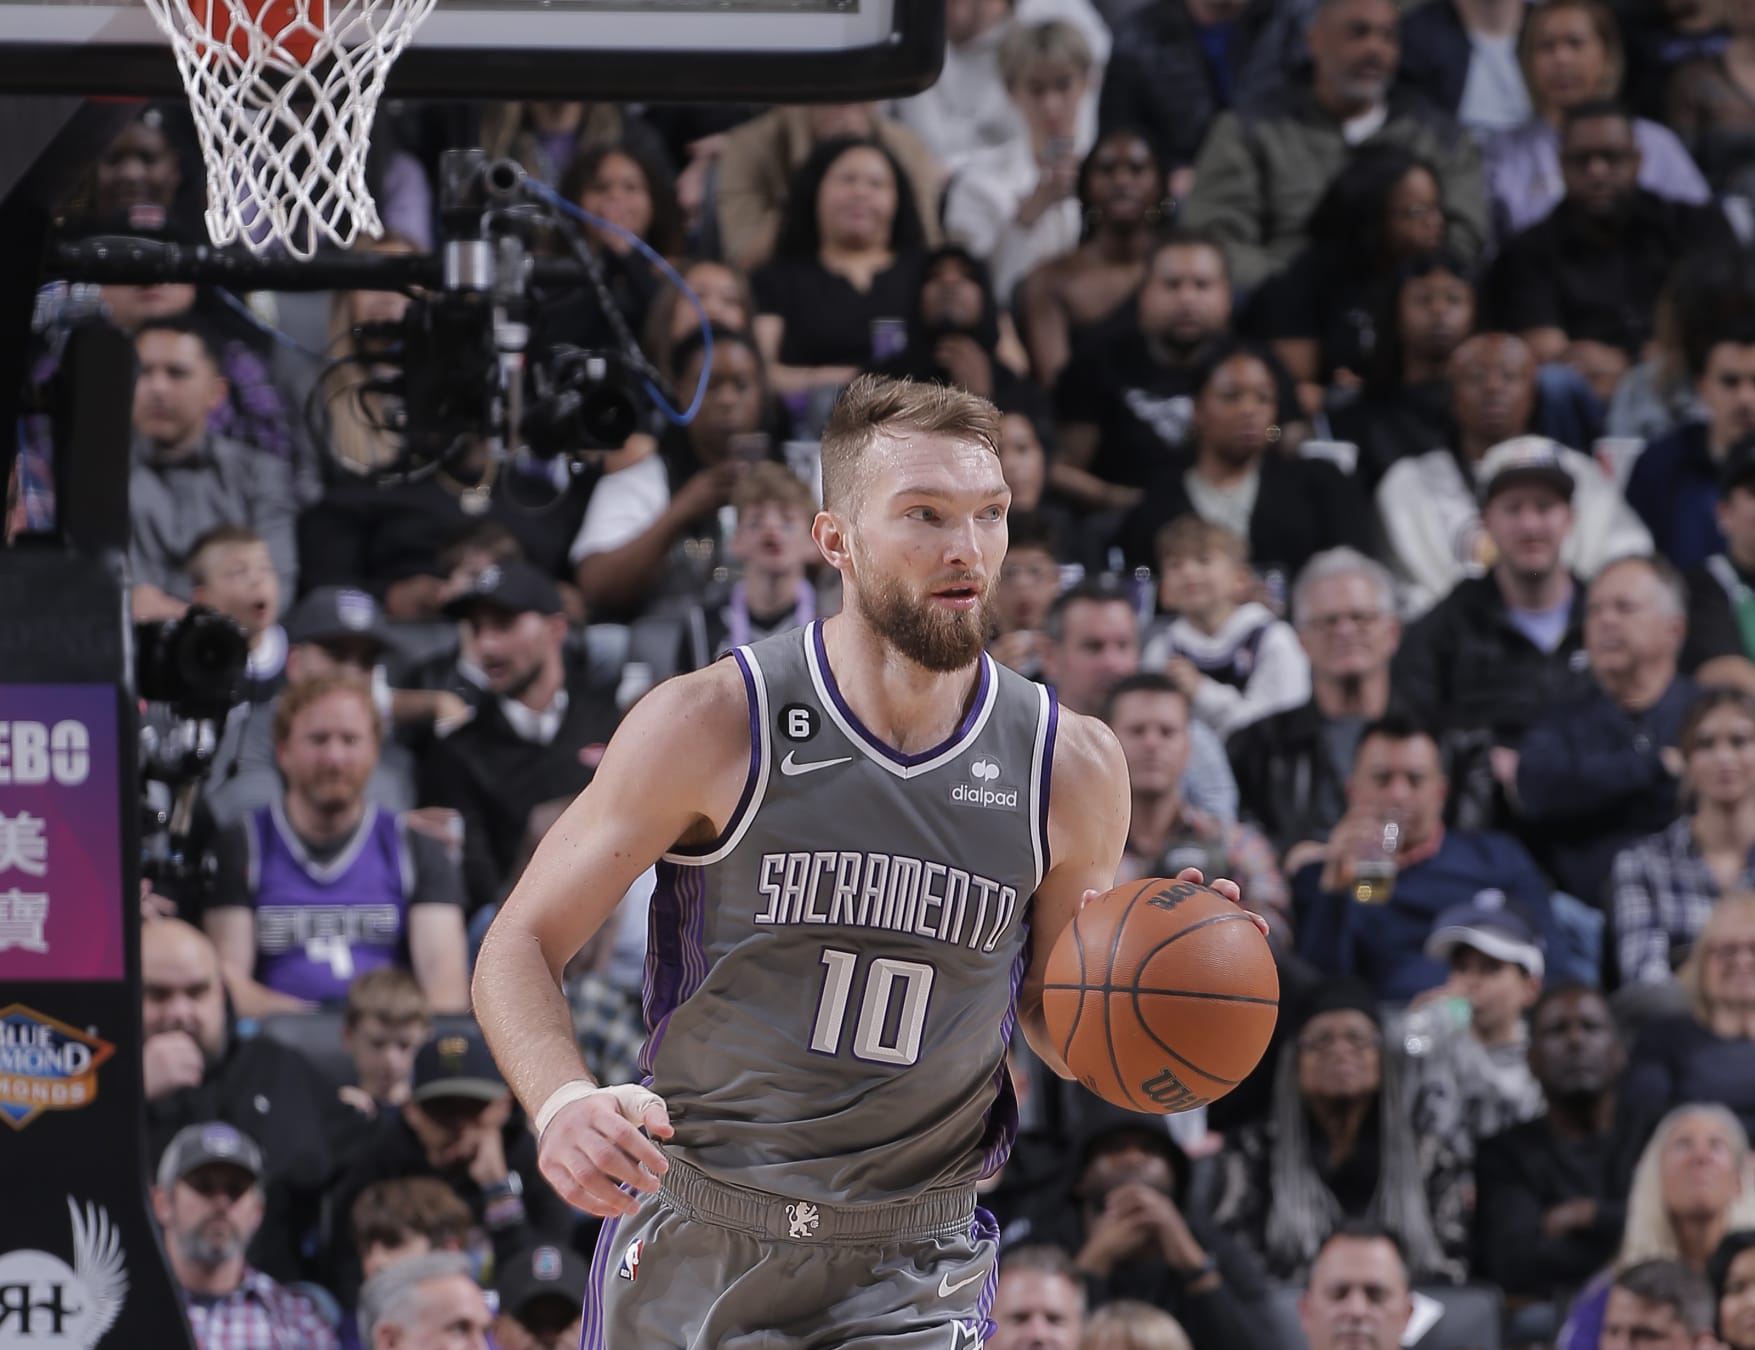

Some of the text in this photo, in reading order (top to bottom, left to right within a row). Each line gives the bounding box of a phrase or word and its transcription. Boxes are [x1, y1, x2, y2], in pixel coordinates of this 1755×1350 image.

[788, 708, 810, 738] 6
[951, 783, 1018, 808] dialpad
[752, 851, 1018, 953] SACRAMENTO
[808, 947, 936, 1068] 10
